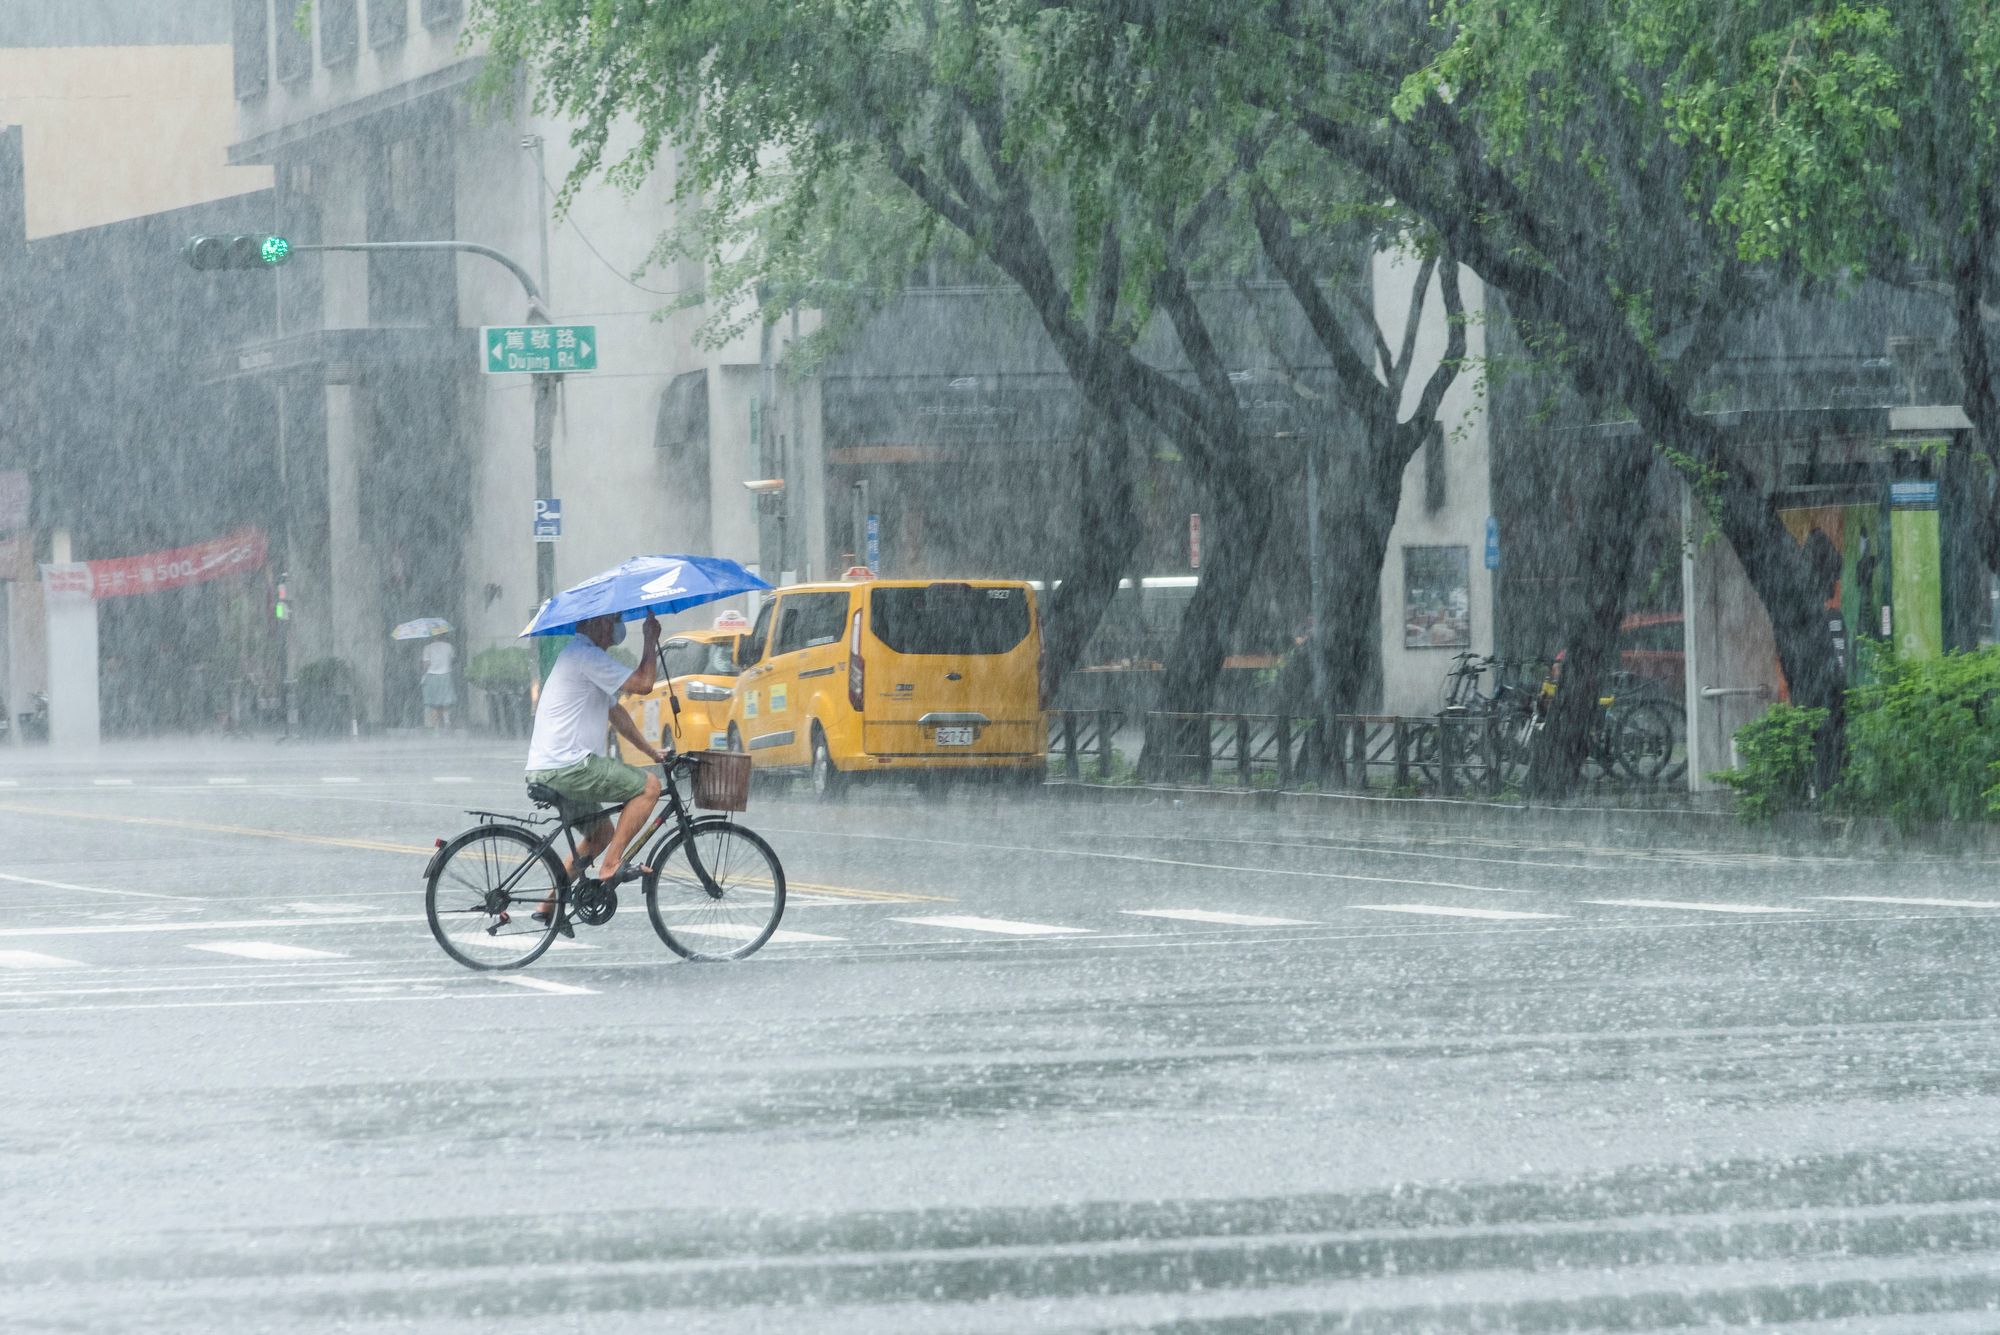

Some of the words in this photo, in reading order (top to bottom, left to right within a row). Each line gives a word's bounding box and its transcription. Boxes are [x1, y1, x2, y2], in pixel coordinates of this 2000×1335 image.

[508, 352, 550, 370] Dujing
[533, 499, 548, 522] P
[640, 586, 688, 601] HONDA
